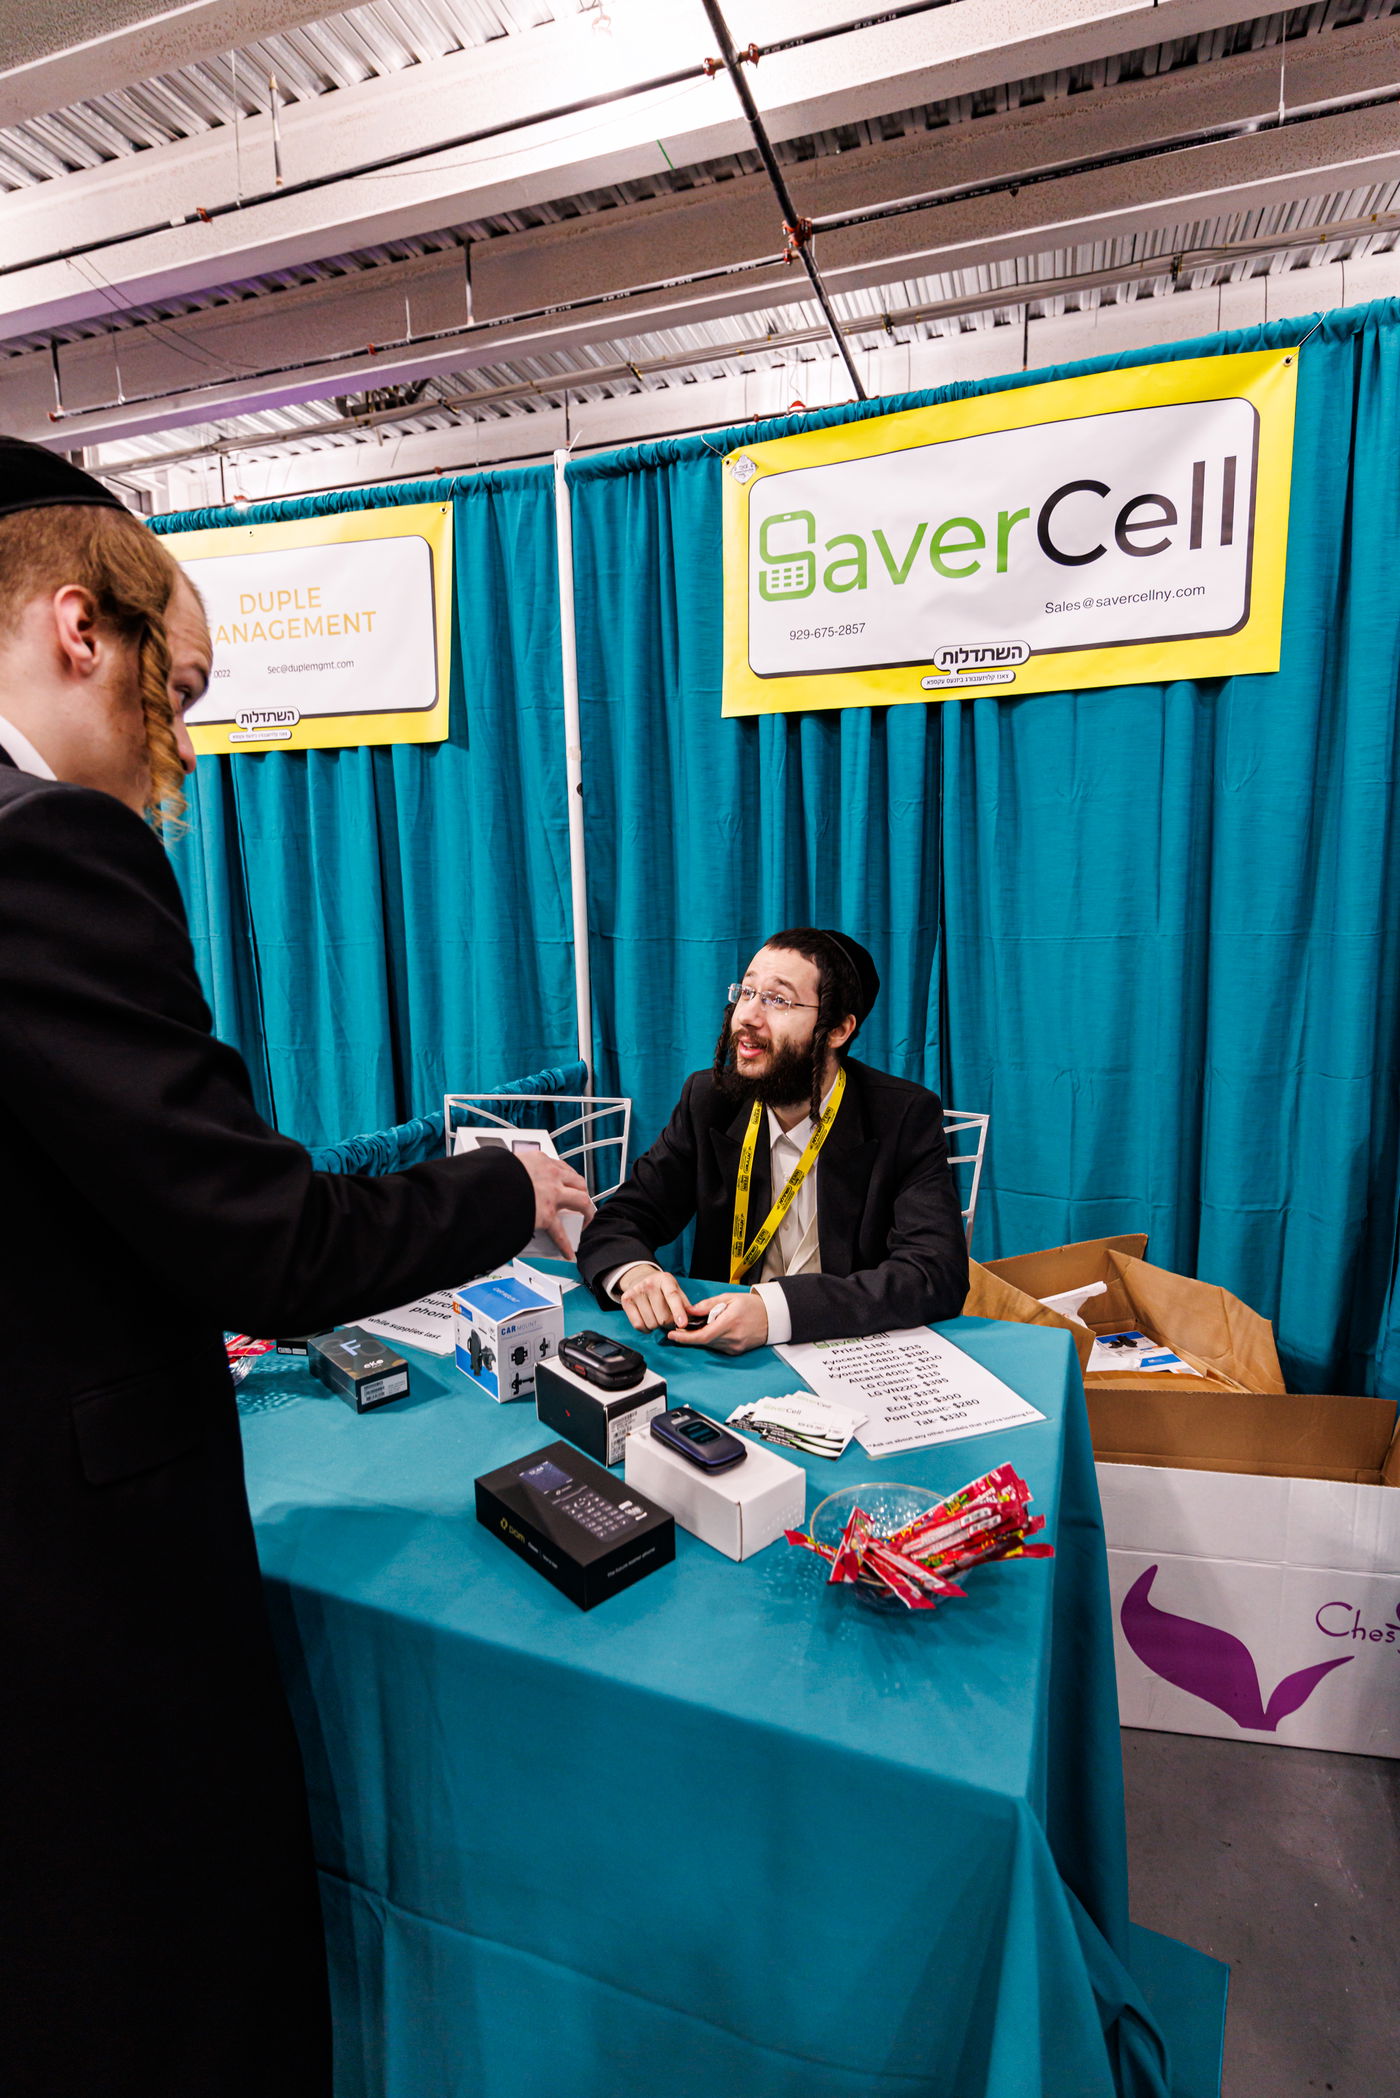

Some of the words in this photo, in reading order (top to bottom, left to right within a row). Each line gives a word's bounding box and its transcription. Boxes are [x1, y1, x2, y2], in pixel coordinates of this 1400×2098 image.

[759, 456, 1237, 601] SaverCell
[239, 587, 322, 615] DUPLE
[209, 611, 377, 645] ANAGEMENT
[789, 622, 866, 641] 929-675-2857
[941, 646, 1023, 665] השתדלות
[240, 710, 295, 724] השתדלות
[409, 1305, 452, 1320] phone
[368, 1316, 389, 1327] while
[389, 1321, 424, 1336] supplies
[423, 1330, 441, 1340] last
[501, 1324, 516, 1336] CAR
[831, 1346, 863, 1354] Price
[822, 1356, 862, 1365] Kyocera
[828, 1362, 868, 1371] Kyocera
[828, 1369, 869, 1378] Kyocera
[848, 1373, 883, 1383] Alcatel
[884, 1414, 910, 1422] Pom
